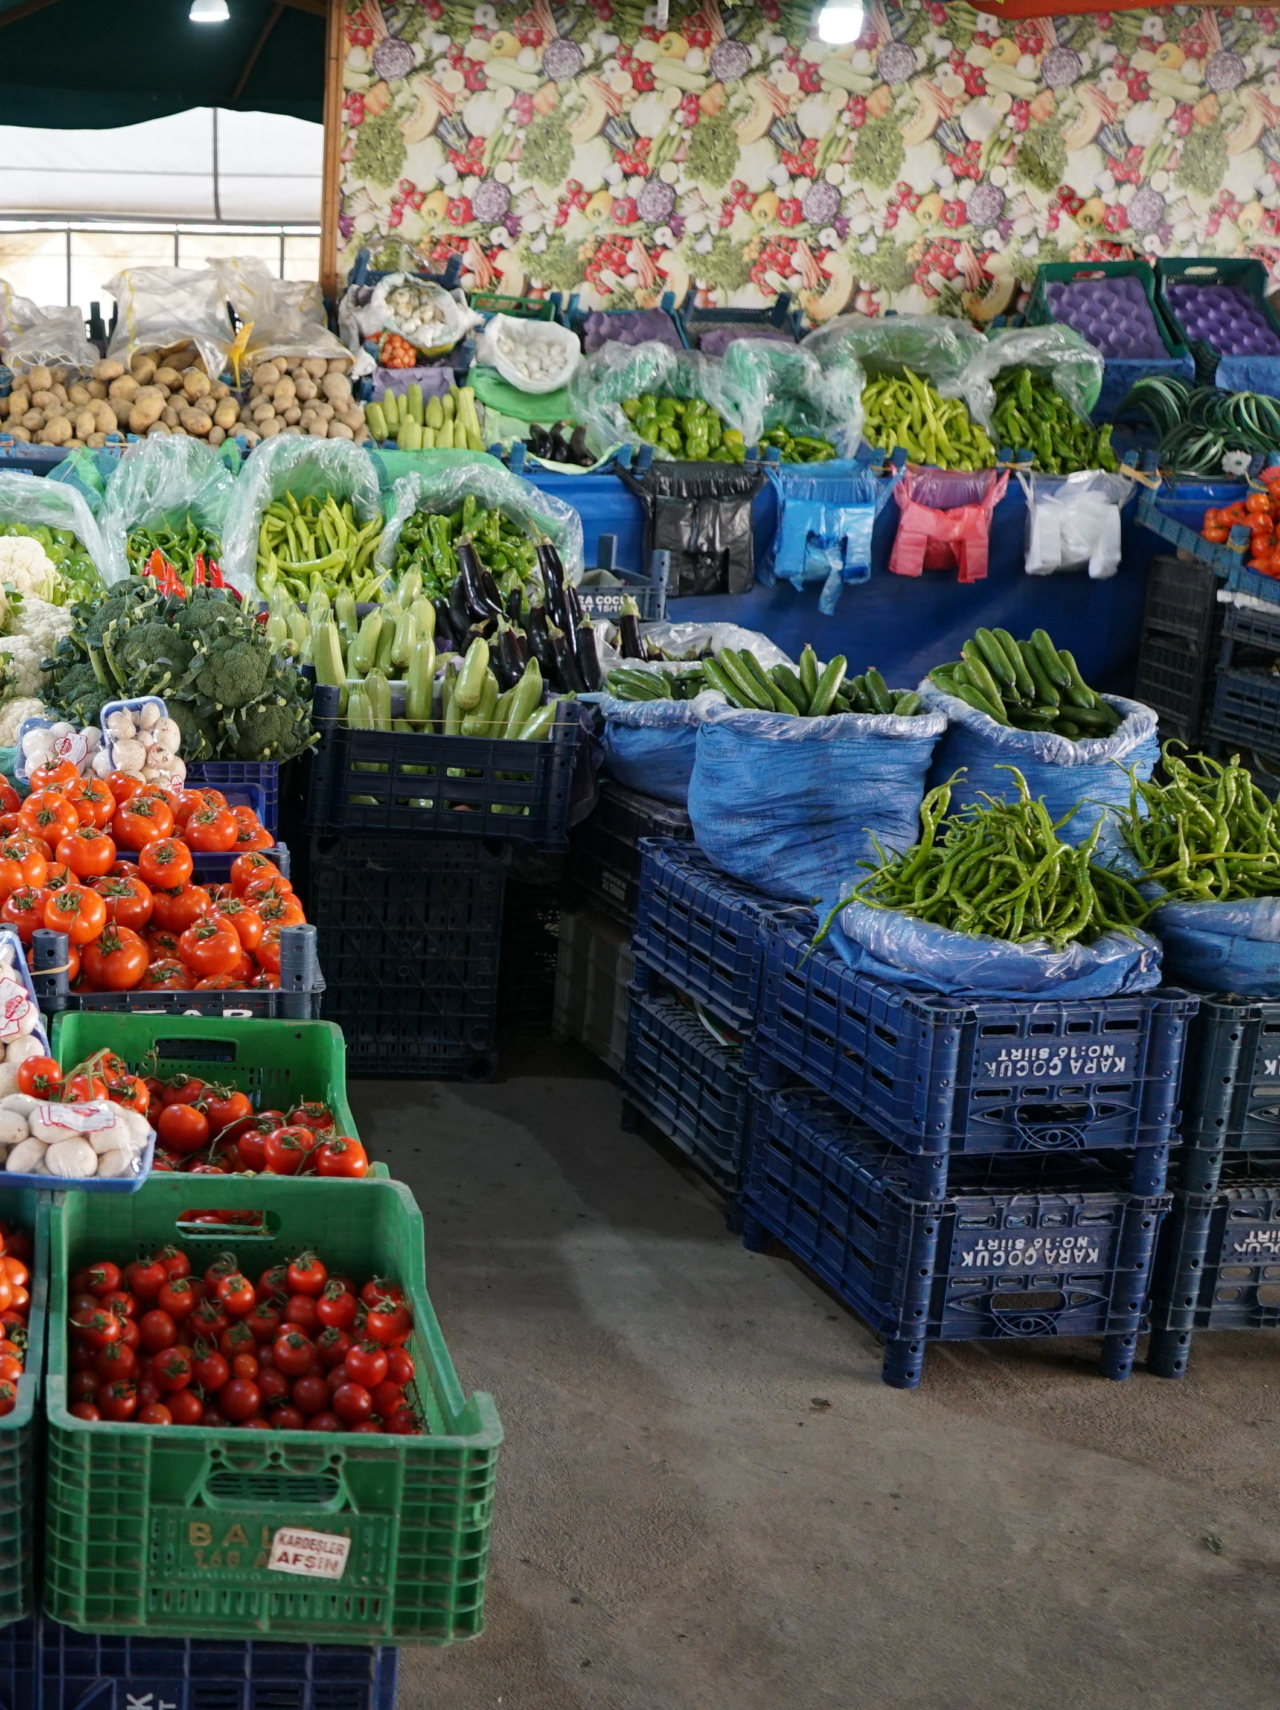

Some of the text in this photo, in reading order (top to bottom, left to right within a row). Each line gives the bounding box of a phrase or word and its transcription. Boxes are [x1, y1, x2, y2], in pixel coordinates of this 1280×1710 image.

[1058, 1044, 1115, 1059] NO:16
[1069, 1056, 1126, 1075] KARA
[1033, 1236, 1089, 1249] NO:16
[961, 1247, 1099, 1267] KARA ÇOCUK
[277, 1531, 345, 1556] KARDEŞLER
